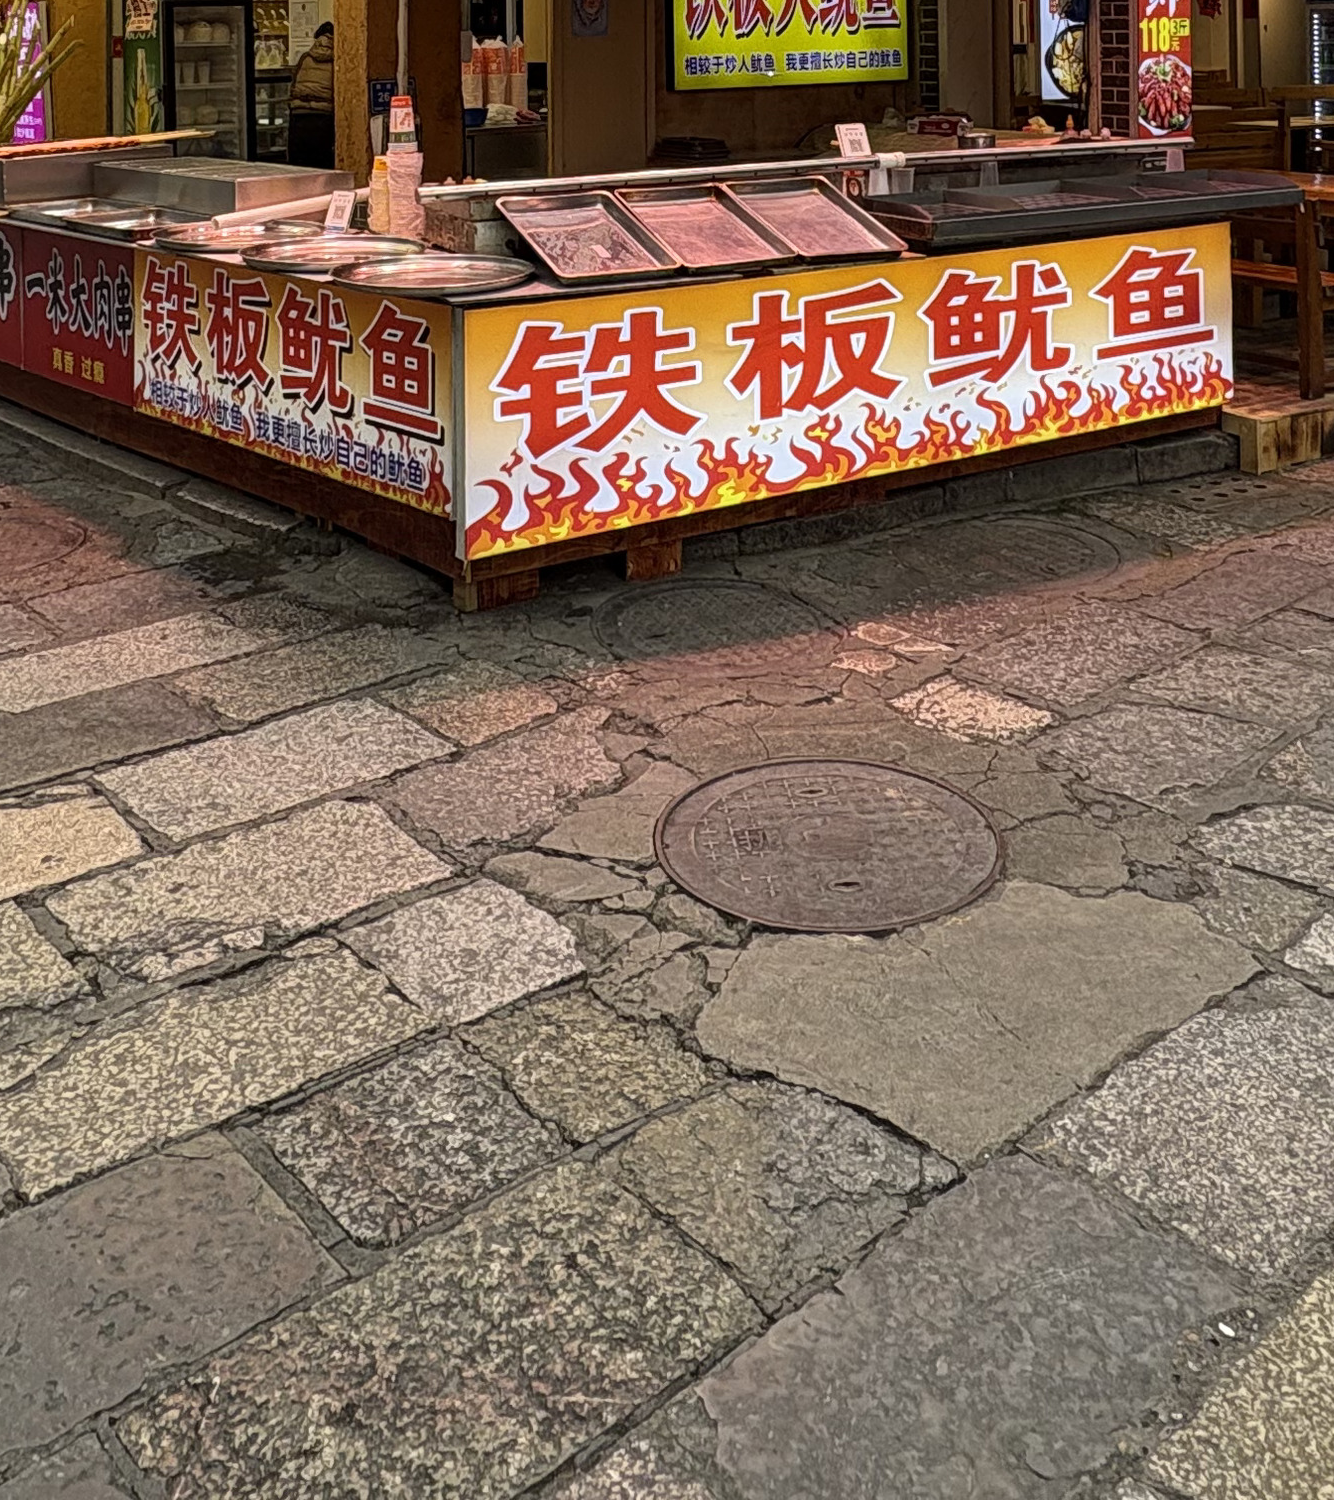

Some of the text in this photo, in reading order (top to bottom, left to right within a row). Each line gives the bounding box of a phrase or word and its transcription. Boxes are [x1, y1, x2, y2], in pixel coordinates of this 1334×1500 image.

[1139, 16, 1170, 53] 118
[25, 247, 135, 357] 一米大肉串
[141, 256, 445, 444] 铁板鱿鱼
[489, 245, 1216, 462] 铁板鱿鱼
[52, 347, 106, 385] 真香 过瘾
[149, 377, 427, 494] 相较于炒人鱿鱼 我更擅长炒自己的鱿鱼
